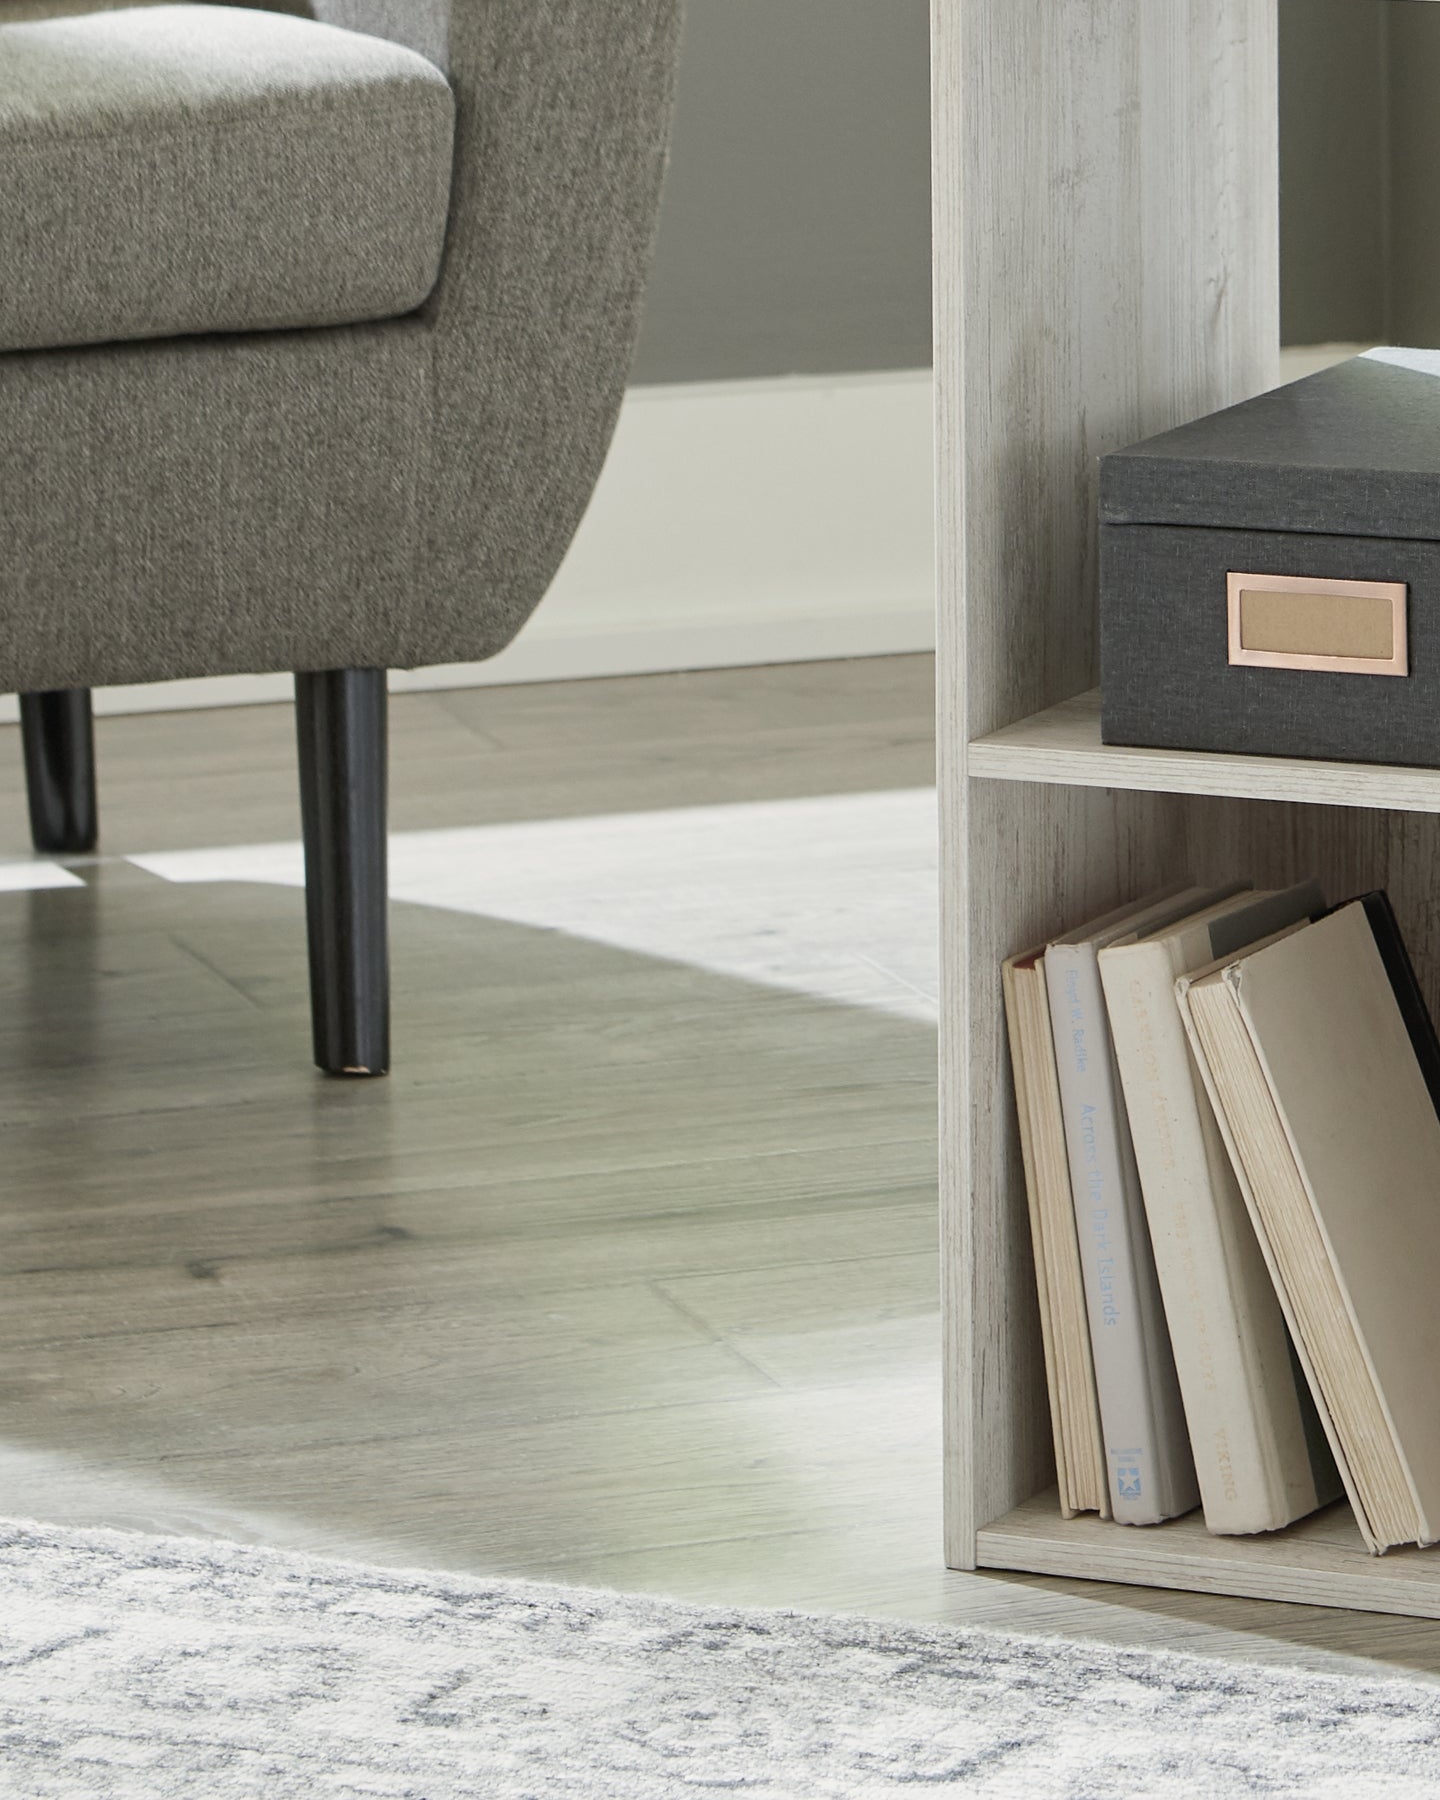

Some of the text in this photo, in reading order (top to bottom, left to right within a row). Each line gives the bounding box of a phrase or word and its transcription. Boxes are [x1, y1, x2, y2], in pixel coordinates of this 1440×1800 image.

[1080, 1103, 1121, 1327] Across the Dark Islands
[1213, 1427, 1239, 1502] VIKING
